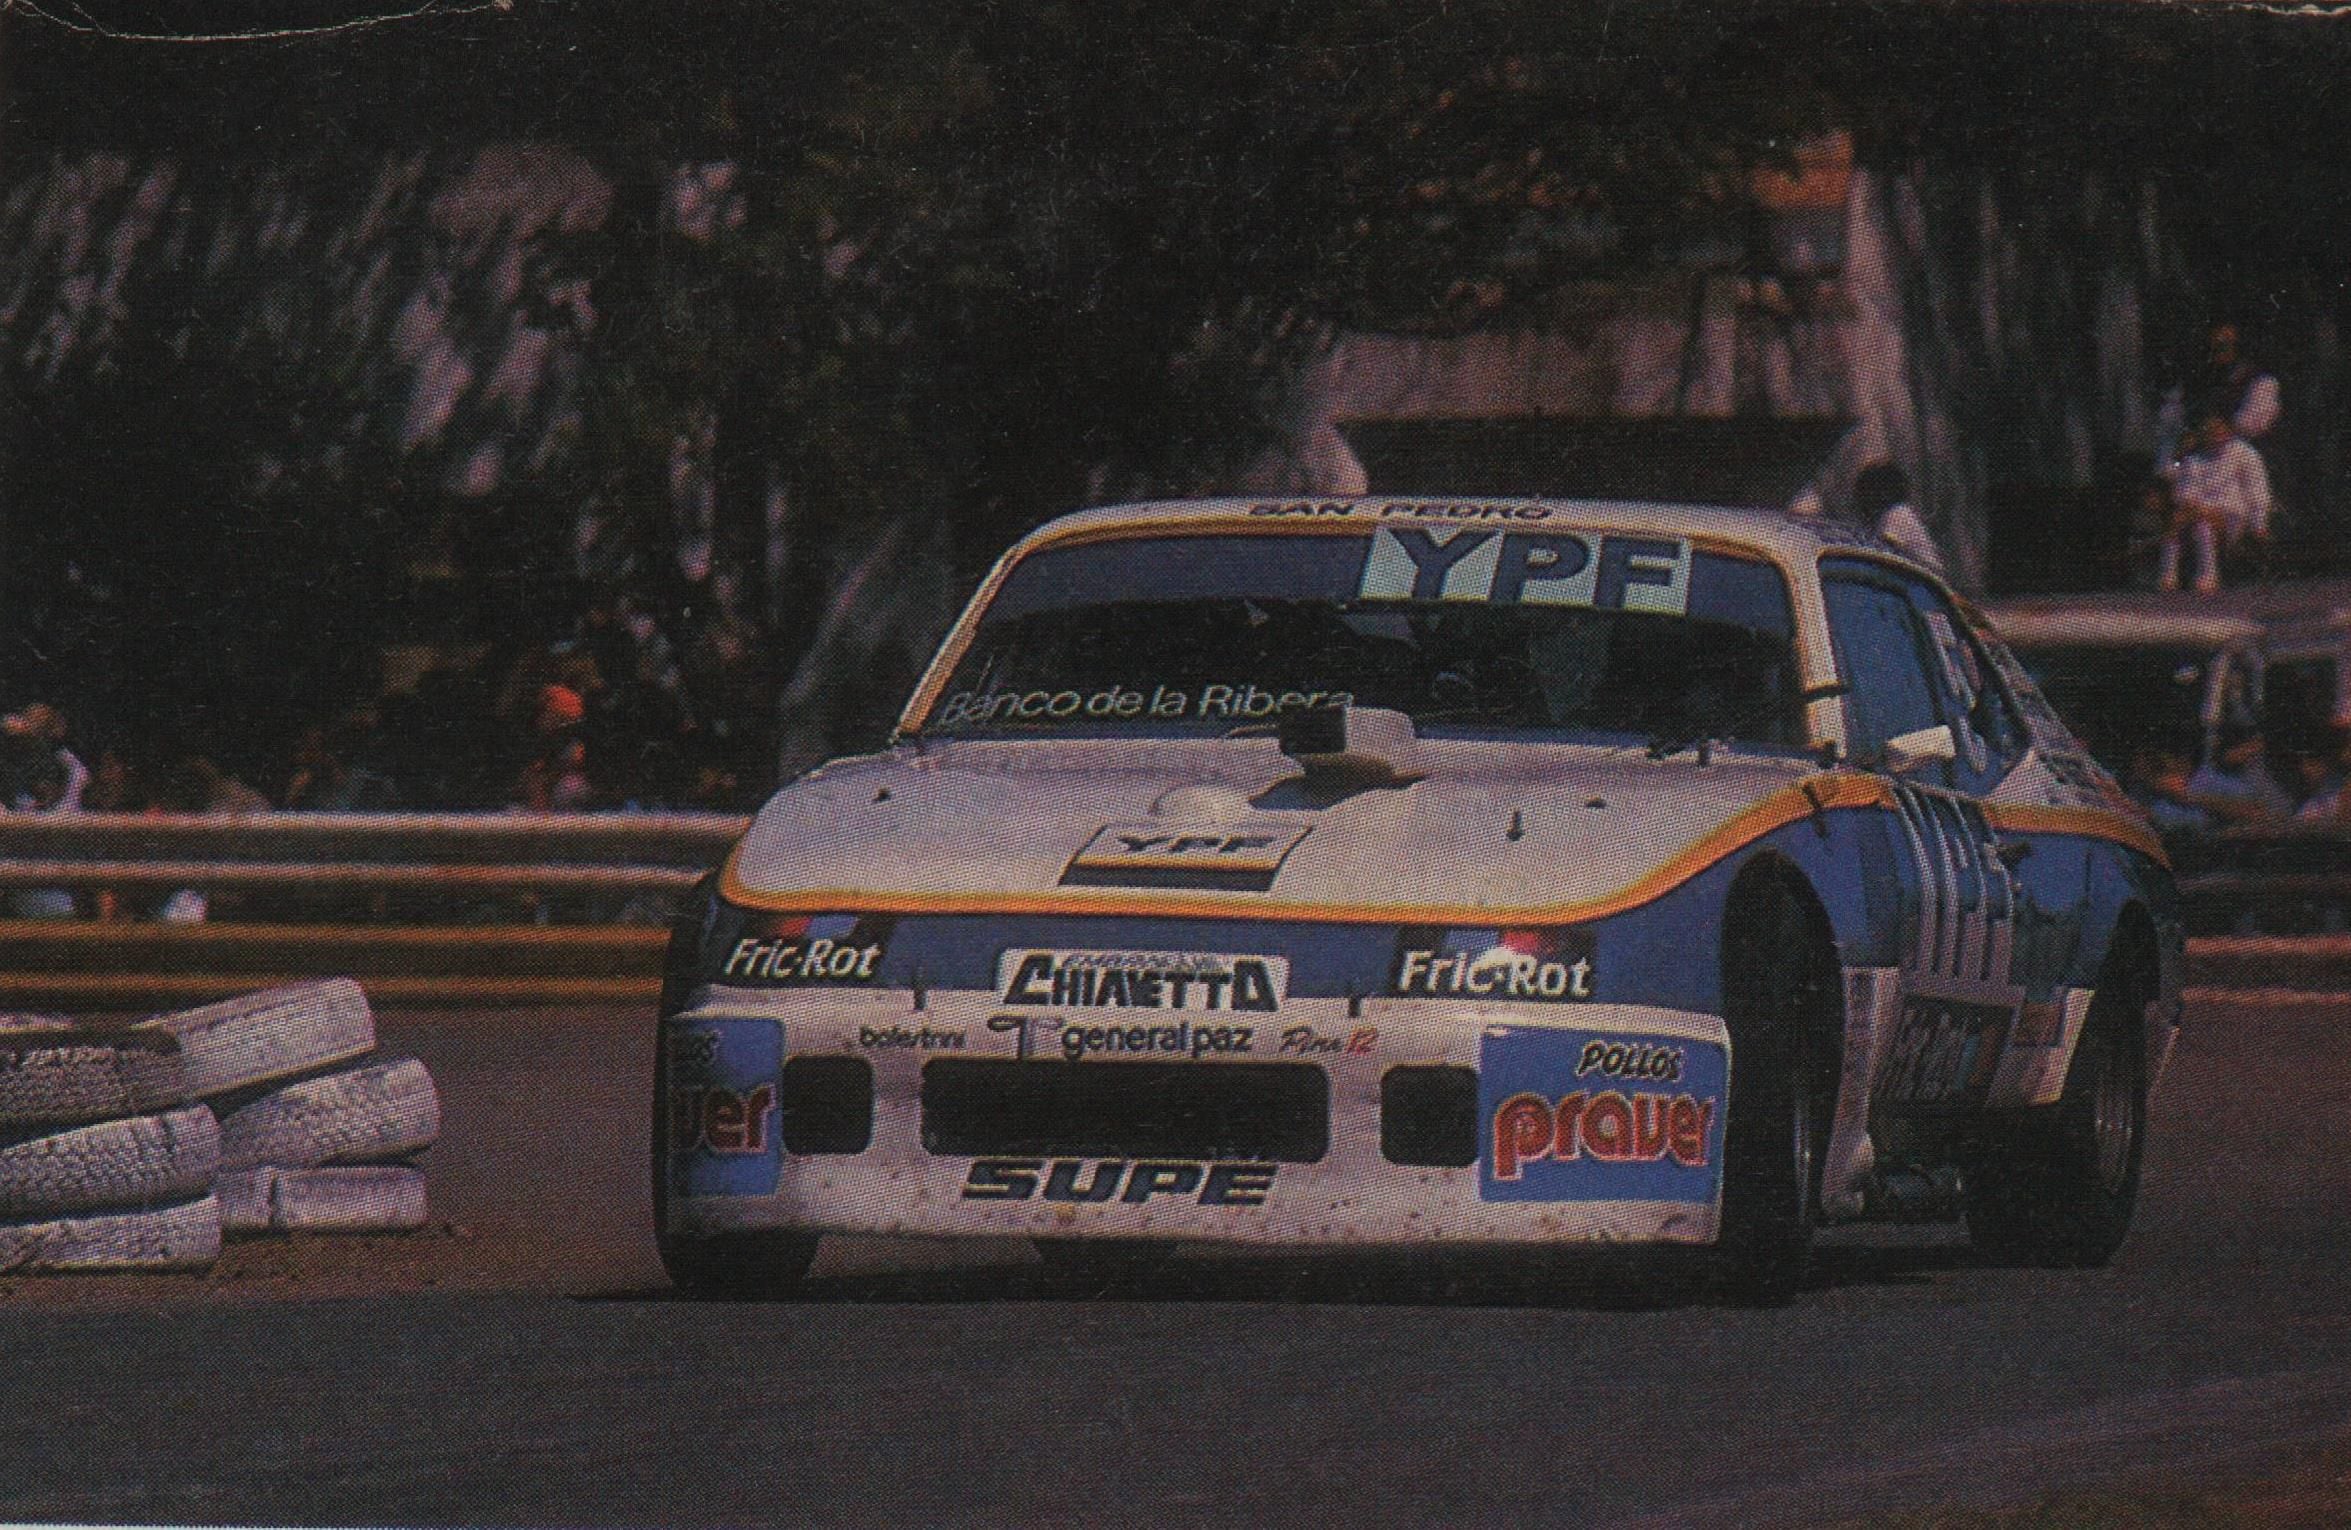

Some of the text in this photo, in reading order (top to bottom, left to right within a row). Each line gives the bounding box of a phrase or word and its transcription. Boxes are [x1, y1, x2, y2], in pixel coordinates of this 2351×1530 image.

[1249, 501, 1551, 520] SAN PEDRO
[1388, 527, 1682, 612] YPF
[940, 689, 1082, 727] Banco
[1086, 684, 1143, 717] de
[1151, 684, 1188, 716] la
[1118, 837, 1276, 853] YPF
[1061, 1020, 1252, 1061] general paz
[1577, 1040, 1685, 1082] POLLOS
[962, 1160, 1277, 1207] SUPE
